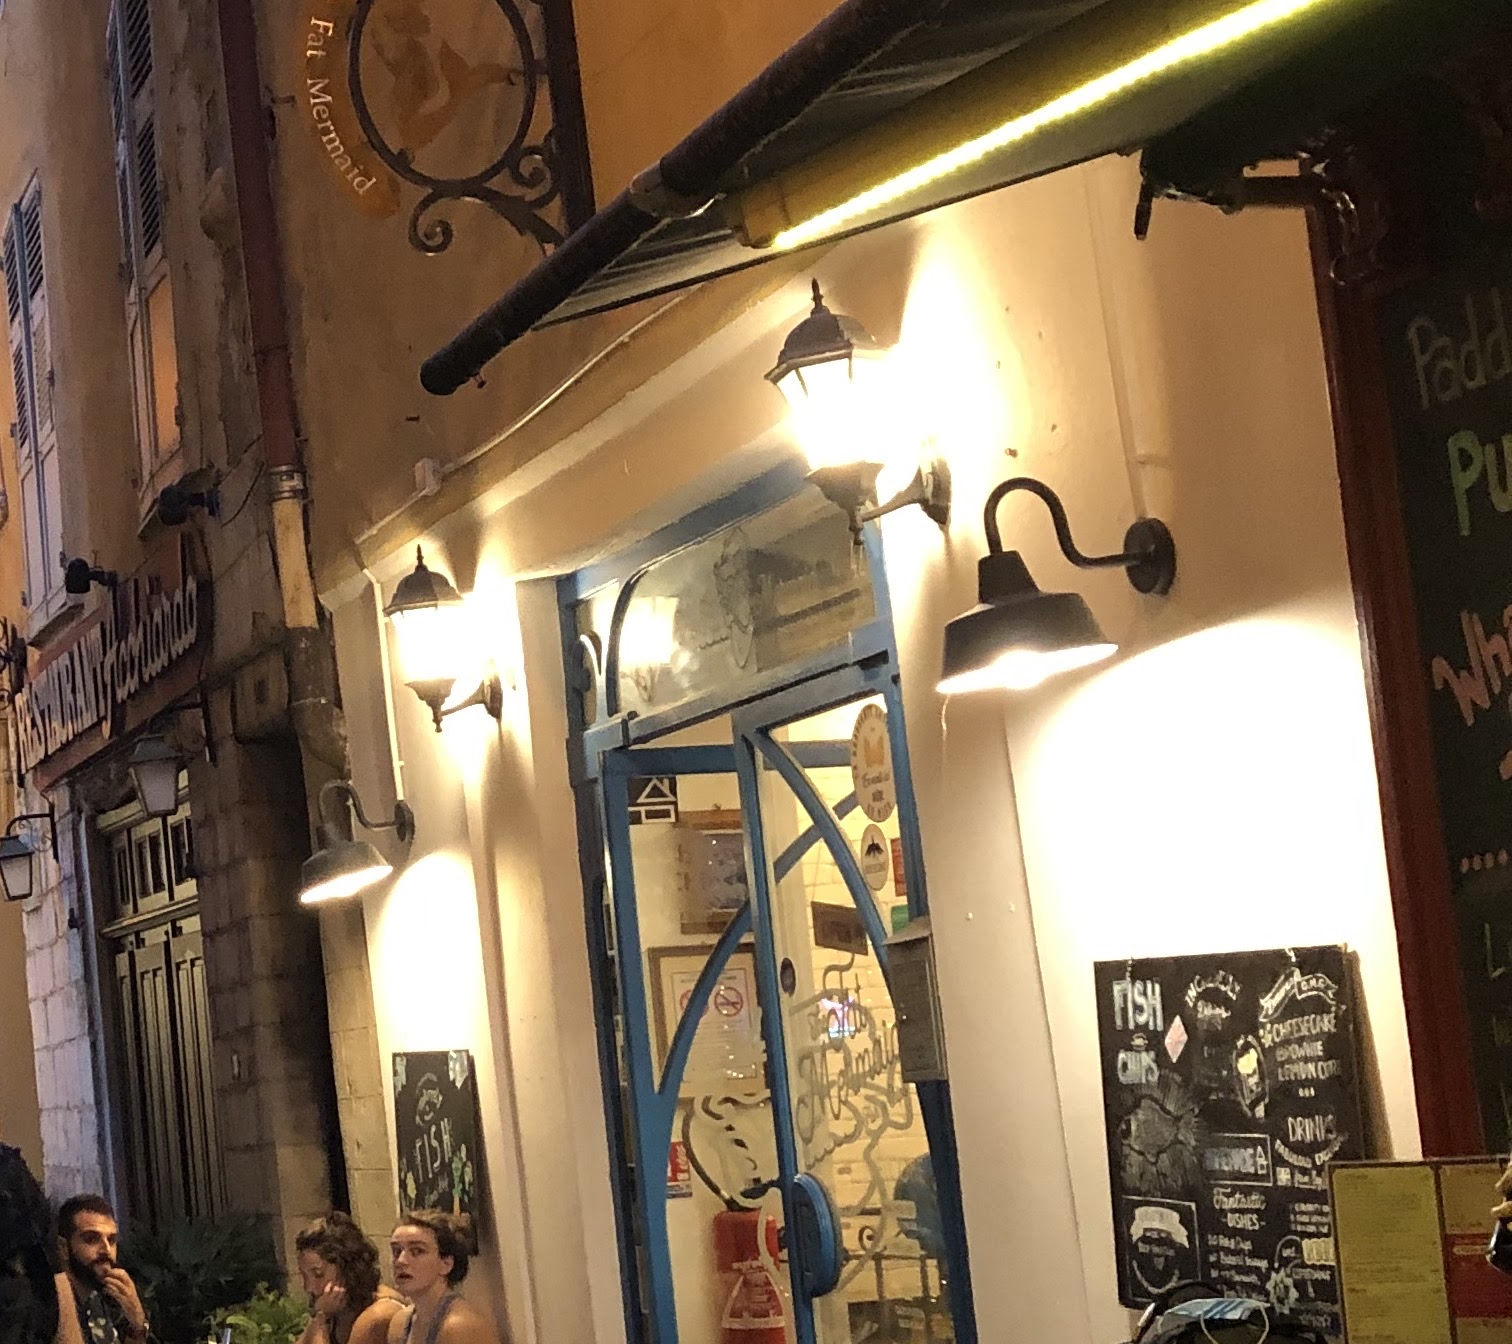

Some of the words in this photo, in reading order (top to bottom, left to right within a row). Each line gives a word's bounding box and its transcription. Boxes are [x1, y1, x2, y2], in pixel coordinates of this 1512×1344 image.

[305, 16, 335, 59] Fat
[307, 76, 377, 198] Mermaid
[1406, 287, 1512, 409] Padd
[1112, 978, 1164, 1032] FISH
[415, 1116, 454, 1184] FISH
